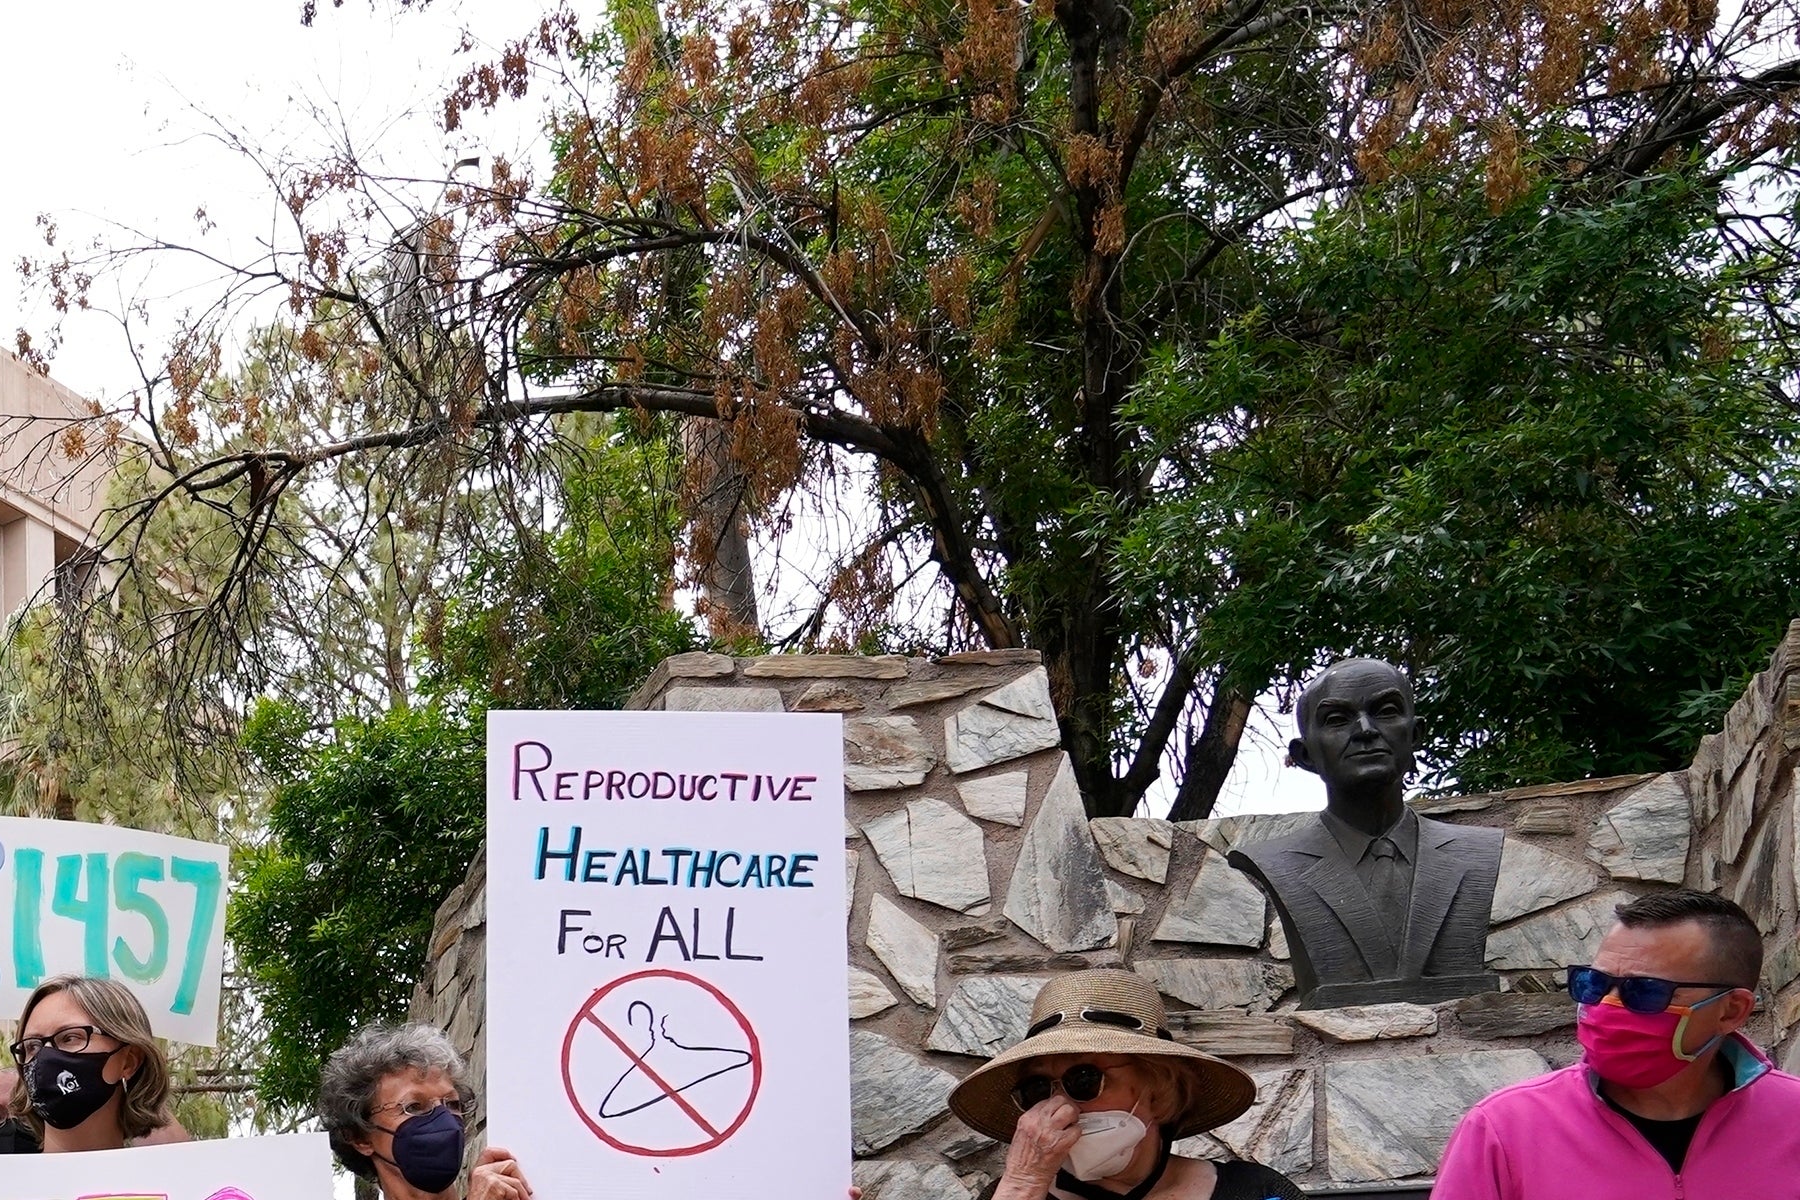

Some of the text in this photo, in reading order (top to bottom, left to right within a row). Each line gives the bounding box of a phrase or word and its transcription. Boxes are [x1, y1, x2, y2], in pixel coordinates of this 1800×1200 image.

[511, 740, 817, 802] REPRODUCTIVE
[534, 826, 819, 888] HEALTHCARE
[12, 848, 222, 1016] 1457
[557, 905, 764, 963] FOR ALL
